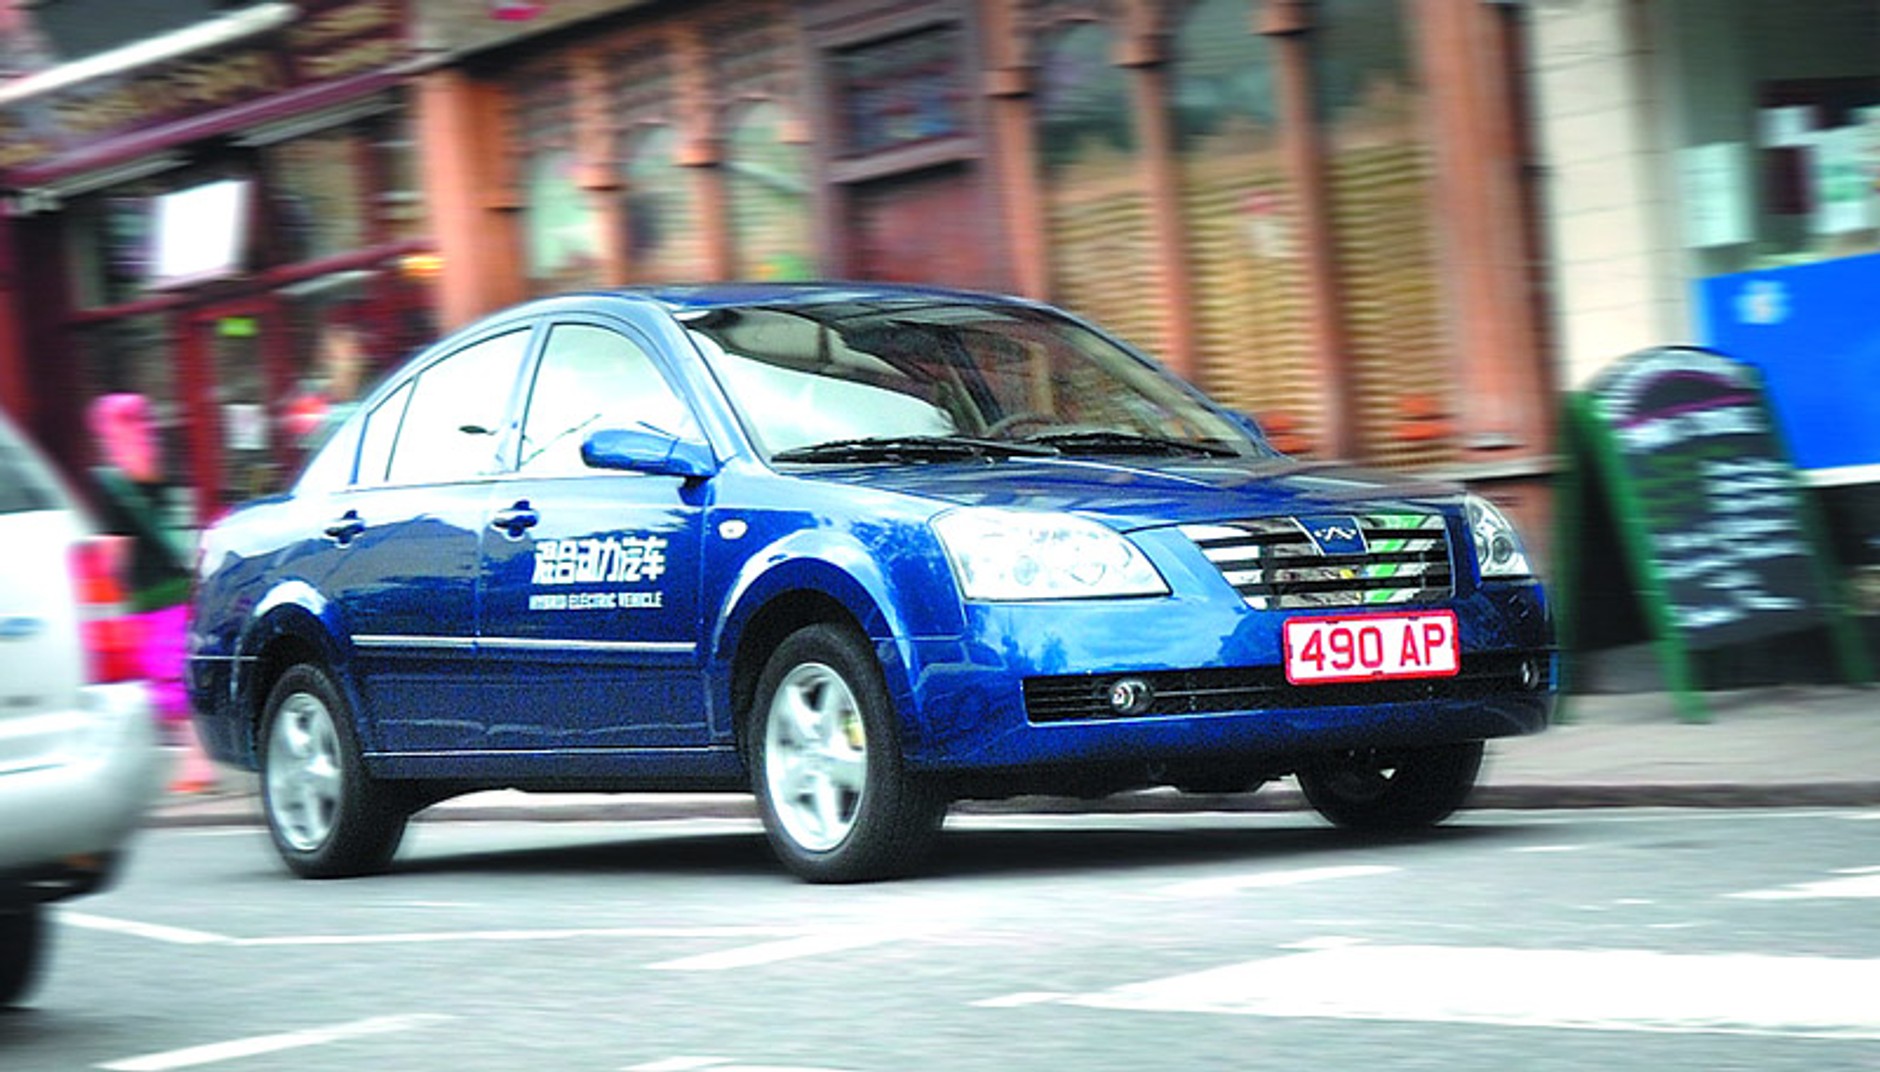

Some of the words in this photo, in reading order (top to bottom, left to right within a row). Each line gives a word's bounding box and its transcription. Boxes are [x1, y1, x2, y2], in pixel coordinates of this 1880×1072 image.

[531, 536, 668, 585] 混合动力汽车
[569, 592, 617, 609] ELECTRIC
[618, 591, 663, 608] VEHICLE
[1300, 626, 1384, 672] 490
[1398, 622, 1446, 667] AP
